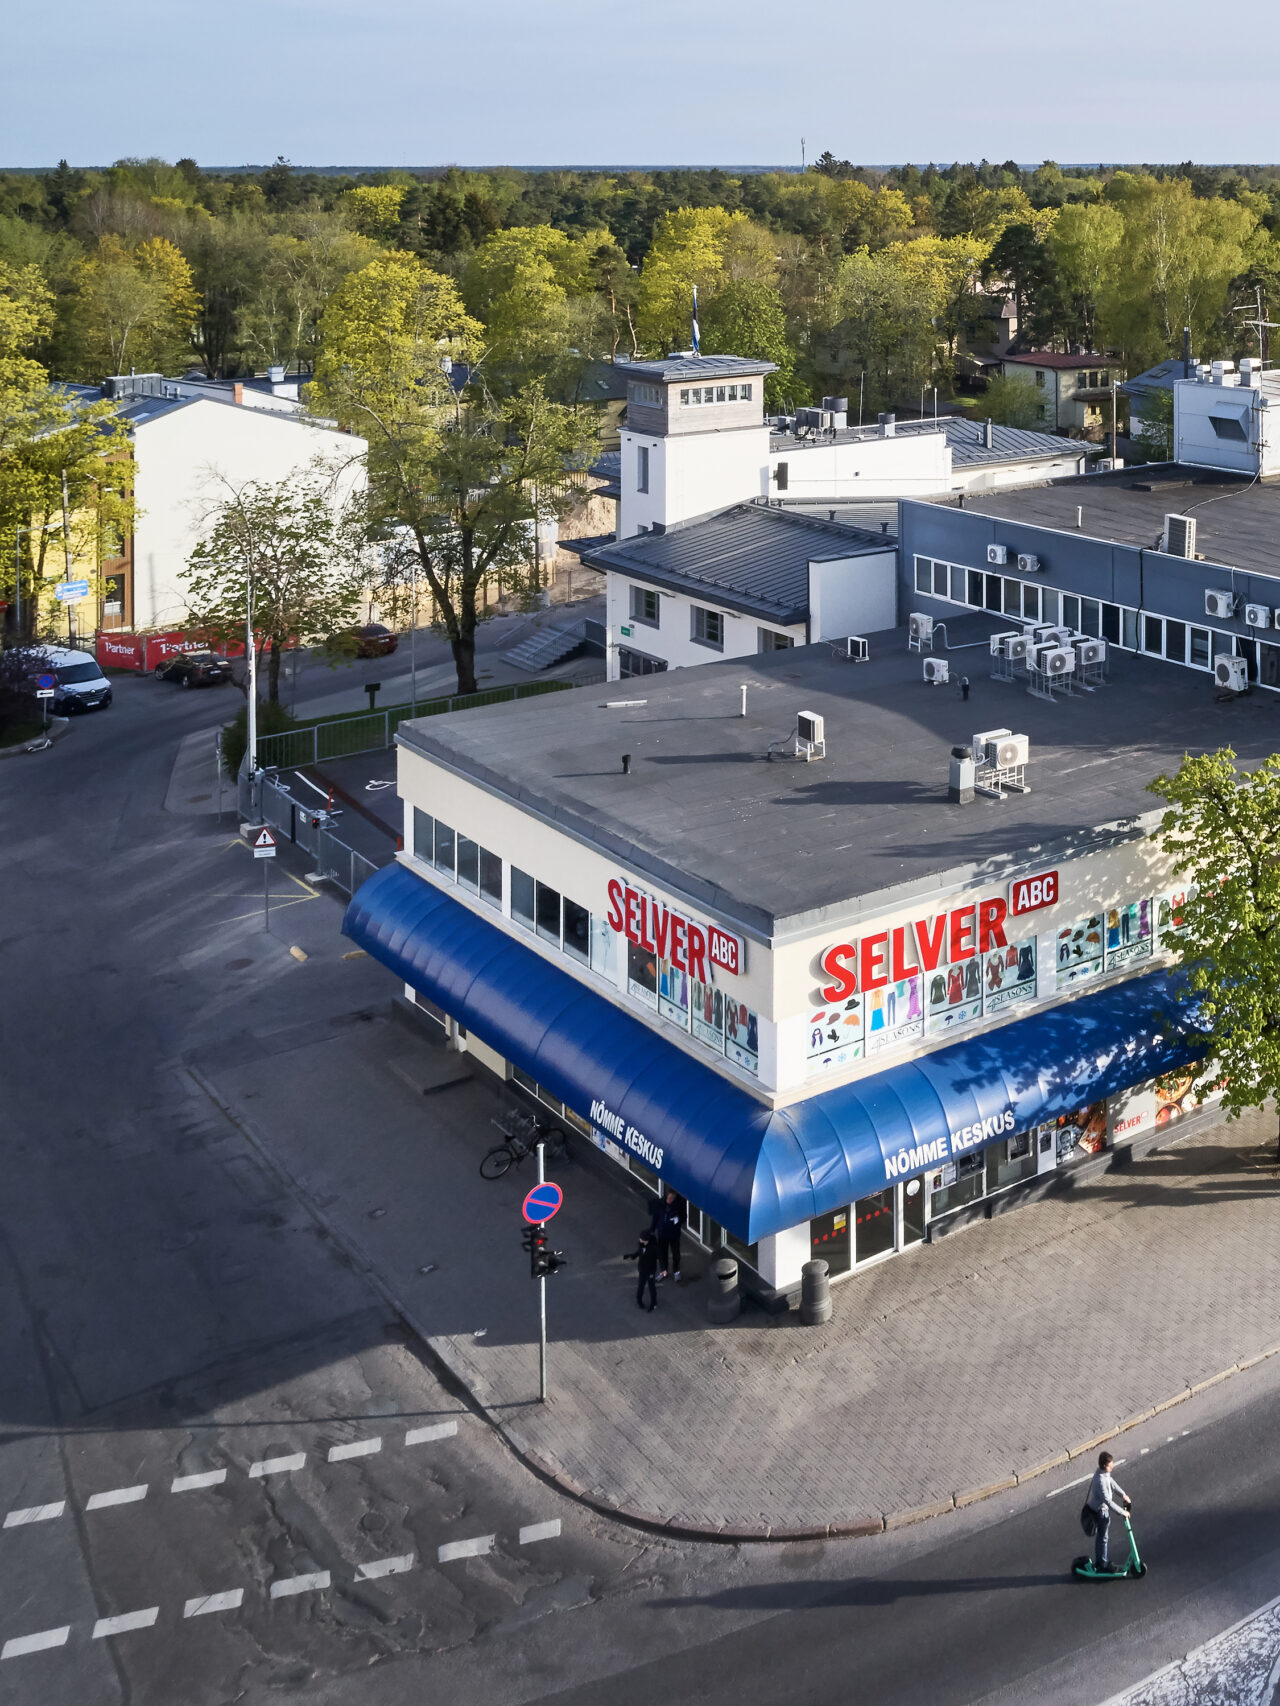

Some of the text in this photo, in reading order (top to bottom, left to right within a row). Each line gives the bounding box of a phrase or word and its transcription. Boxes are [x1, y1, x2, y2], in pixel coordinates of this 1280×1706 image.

[608, 878, 736, 985] SELVER ABC
[820, 876, 1054, 1004] SELVER ABC
[590, 1100, 664, 1169] NÕMME KESKUS
[884, 1110, 1015, 1180] NÕMME KESKUS
[1113, 1116, 1141, 1134] SELVER
